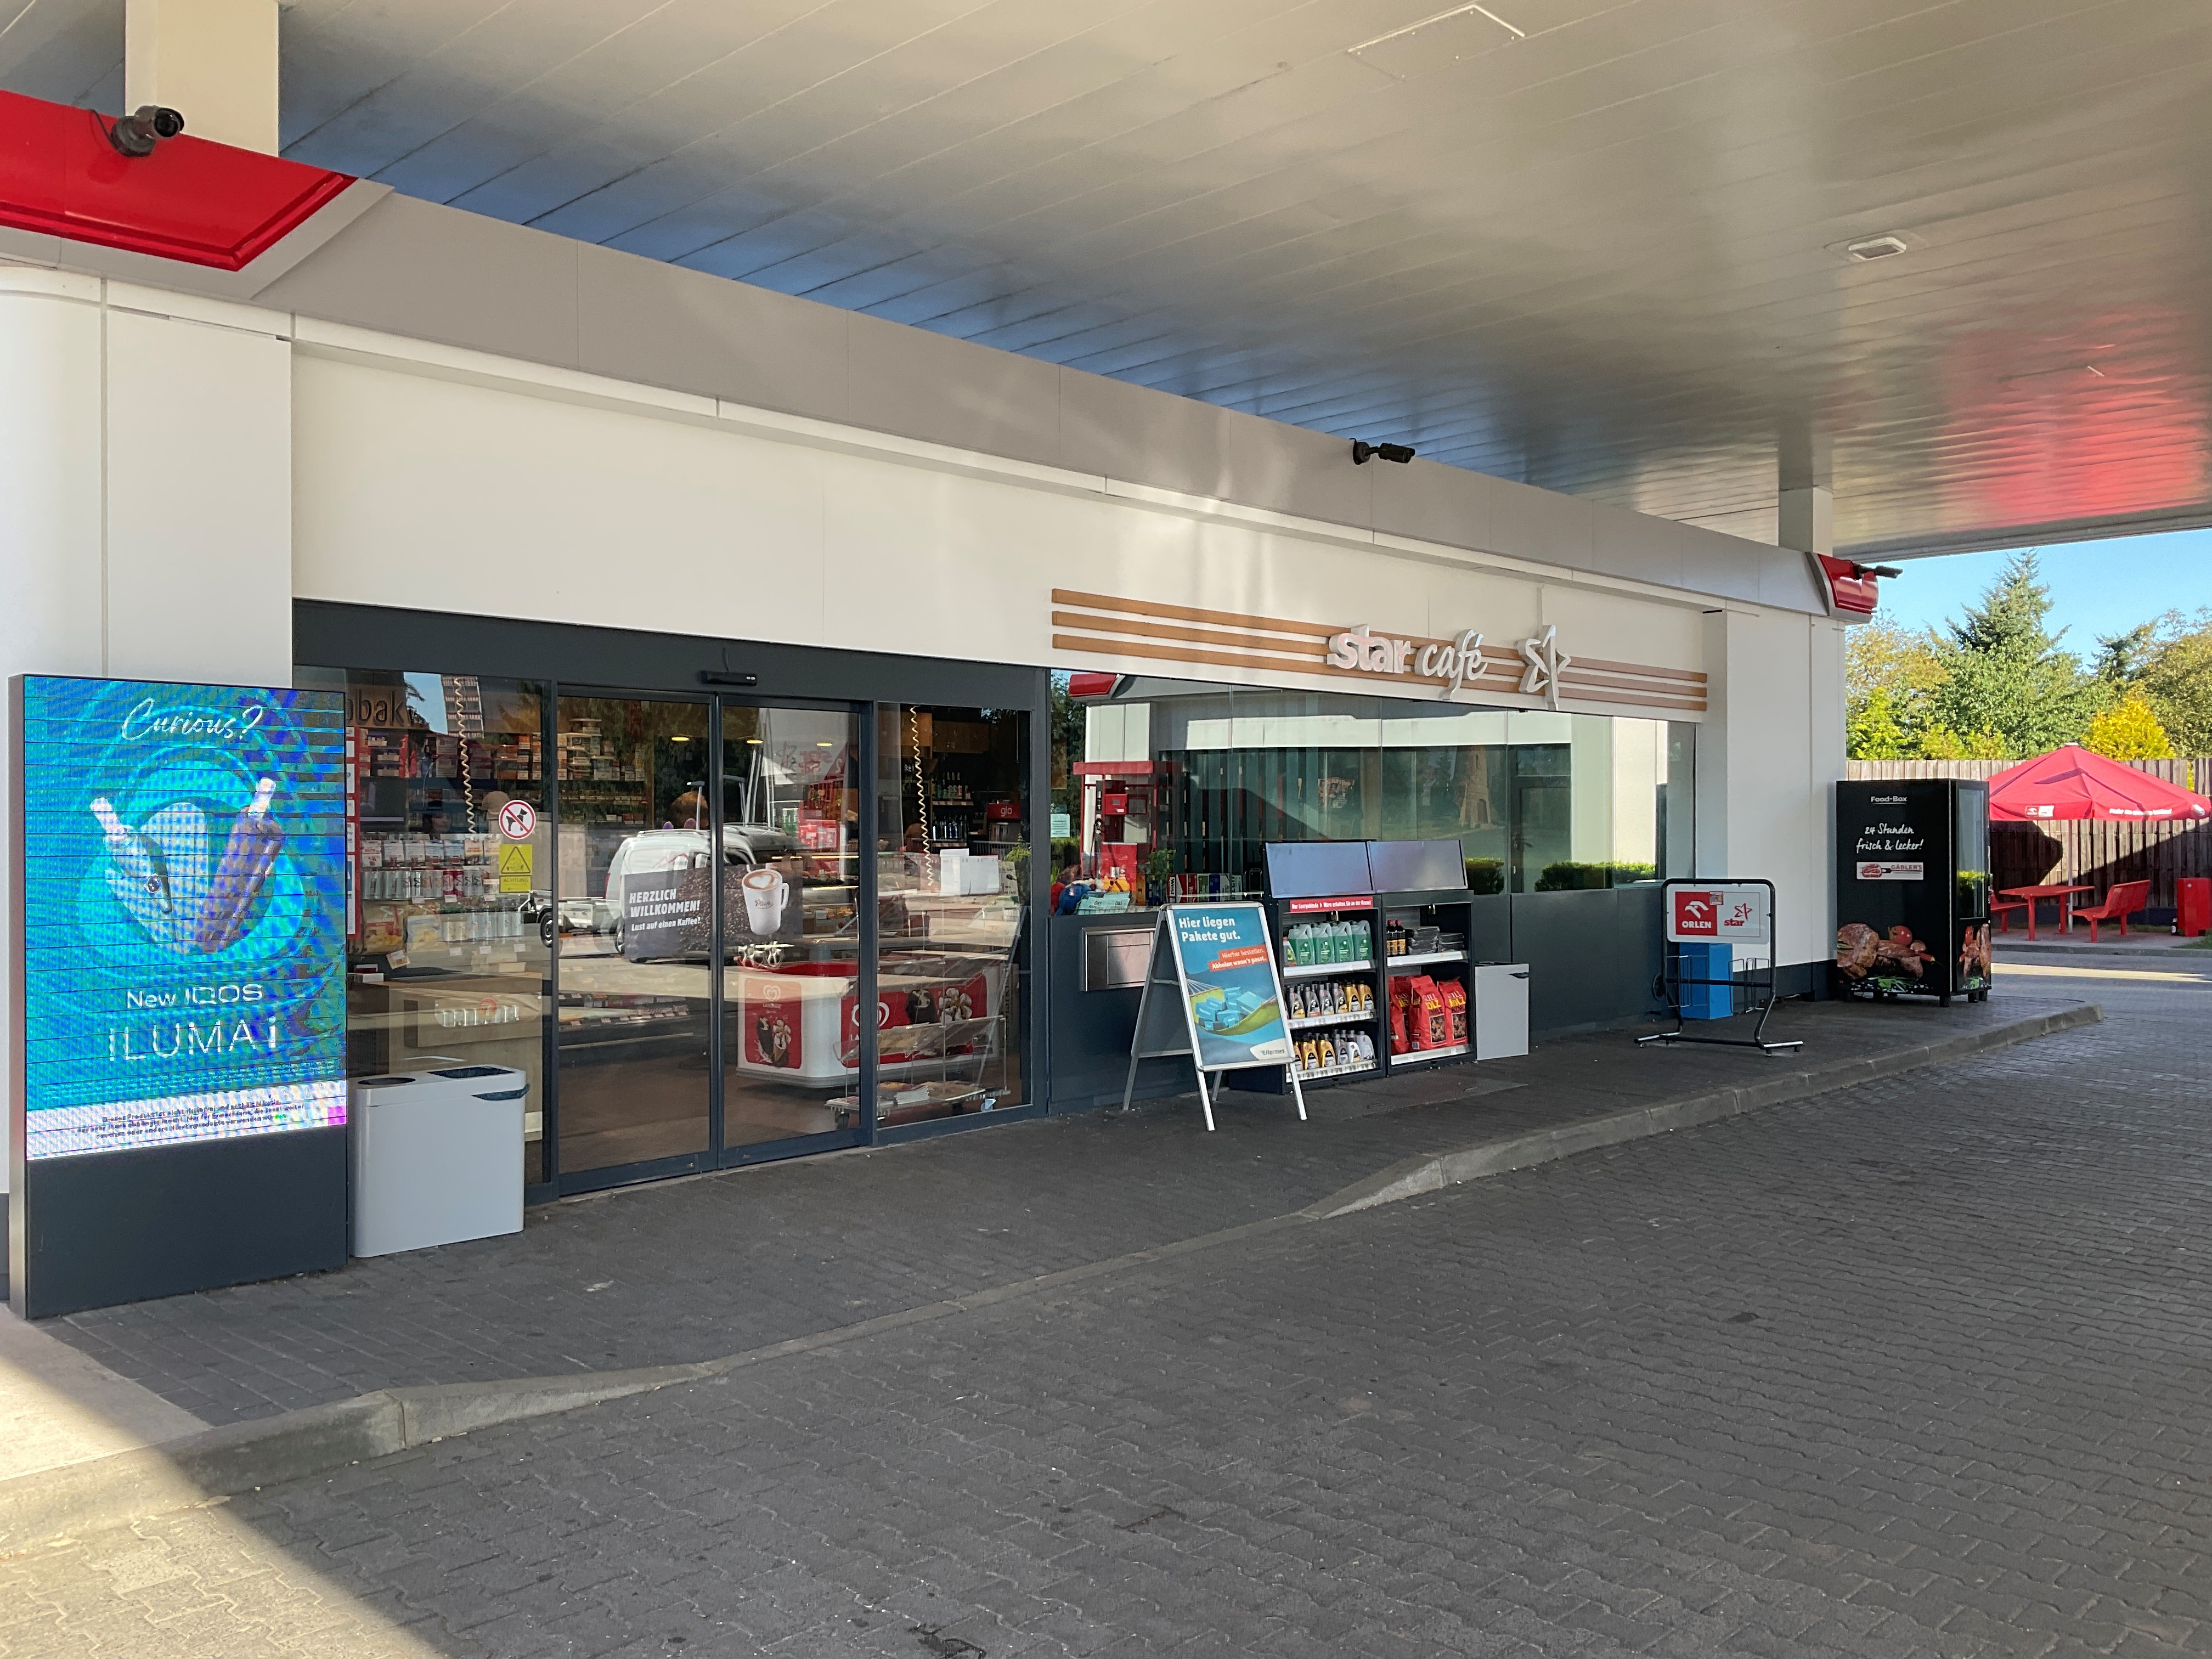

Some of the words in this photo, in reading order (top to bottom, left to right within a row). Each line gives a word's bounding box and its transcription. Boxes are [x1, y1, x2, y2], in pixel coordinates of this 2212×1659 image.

[1327, 624, 1411, 674] star
[1415, 629, 1488, 700] café
[122, 698, 263, 740] Curious?
[1001, 805, 1012, 817] glo
[1865, 826, 1876, 834] 24
[1877, 823, 1914, 834] Stunden
[1857, 838, 1882, 854] frisch
[1884, 839, 1894, 850] &
[1895, 838, 1924, 850] lecker!
[629, 888, 677, 904] HERZLICH
[630, 900, 701, 917] WILLKOMMEN!
[631, 923, 645, 931] Lust
[646, 921, 658, 929] auf
[658, 920, 676, 928] einen
[678, 917, 701, 926] Kaffee?
[1178, 917, 1200, 928] Hier
[1203, 916, 1235, 929] liegen
[1681, 921, 1712, 929] ORLEN
[1181, 930, 1218, 942] Pakete
[1220, 930, 1241, 943] gut.
[1212, 961, 1233, 969] Abholen
[127, 991, 176, 1008] New
[185, 984, 263, 1005] IQOS
[1425, 999, 1441, 1009] OLZ
[110, 1019, 257, 1061] ILUMA
